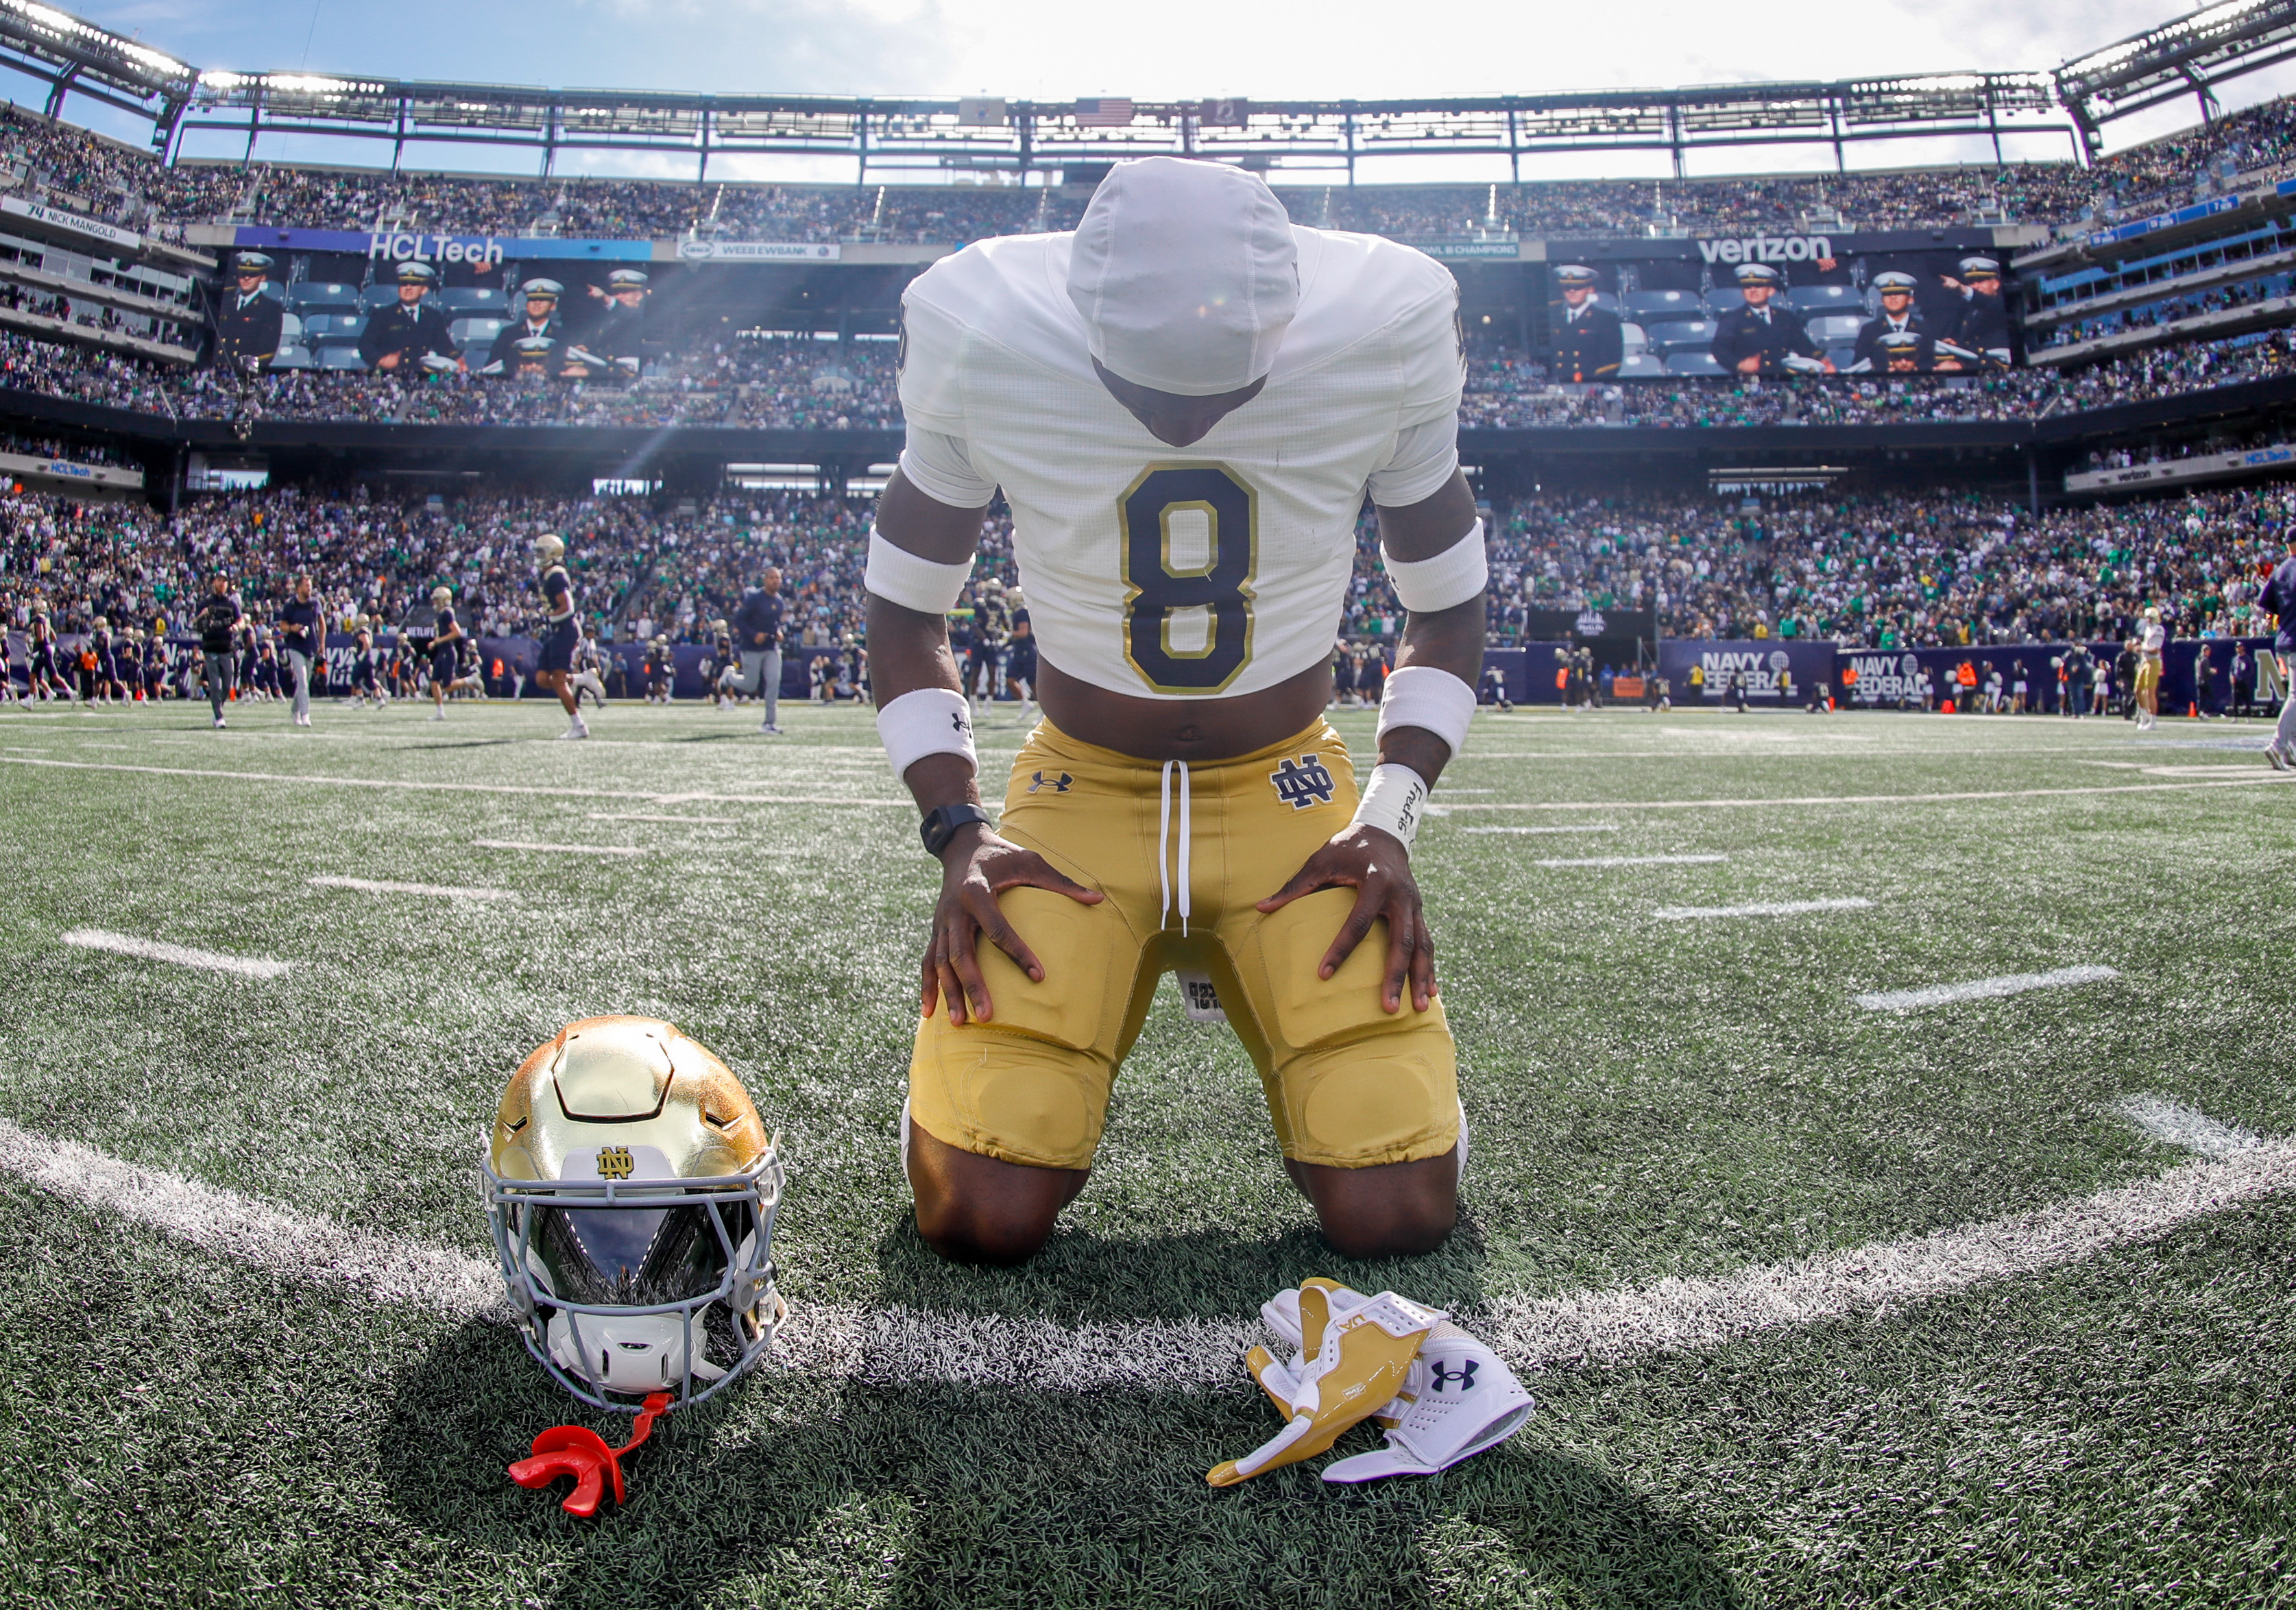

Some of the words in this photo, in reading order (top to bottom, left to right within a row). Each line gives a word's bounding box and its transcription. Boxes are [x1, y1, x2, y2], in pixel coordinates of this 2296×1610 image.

[27, 204, 45, 219] 74
[48, 210, 69, 225] NICK
[70, 217, 117, 239] MANGOLD
[368, 233, 503, 265] HCLTech
[723, 245, 755, 254] WEEB
[758, 245, 808, 255] EWBANK
[1418, 245, 1442, 254] OWL
[1455, 245, 1516, 254] CHAMPIONS
[1697, 230, 1833, 264] verizon
[51, 462, 90, 477] HCLTech
[1116, 460, 1259, 694] 8
[406, 626, 435, 638] METLIFE
[1702, 652, 1765, 671] NAVY
[1851, 656, 1898, 675] NAVY
[1704, 670, 1798, 689] FEERAL
[1338, 1313, 1366, 1330] UA
